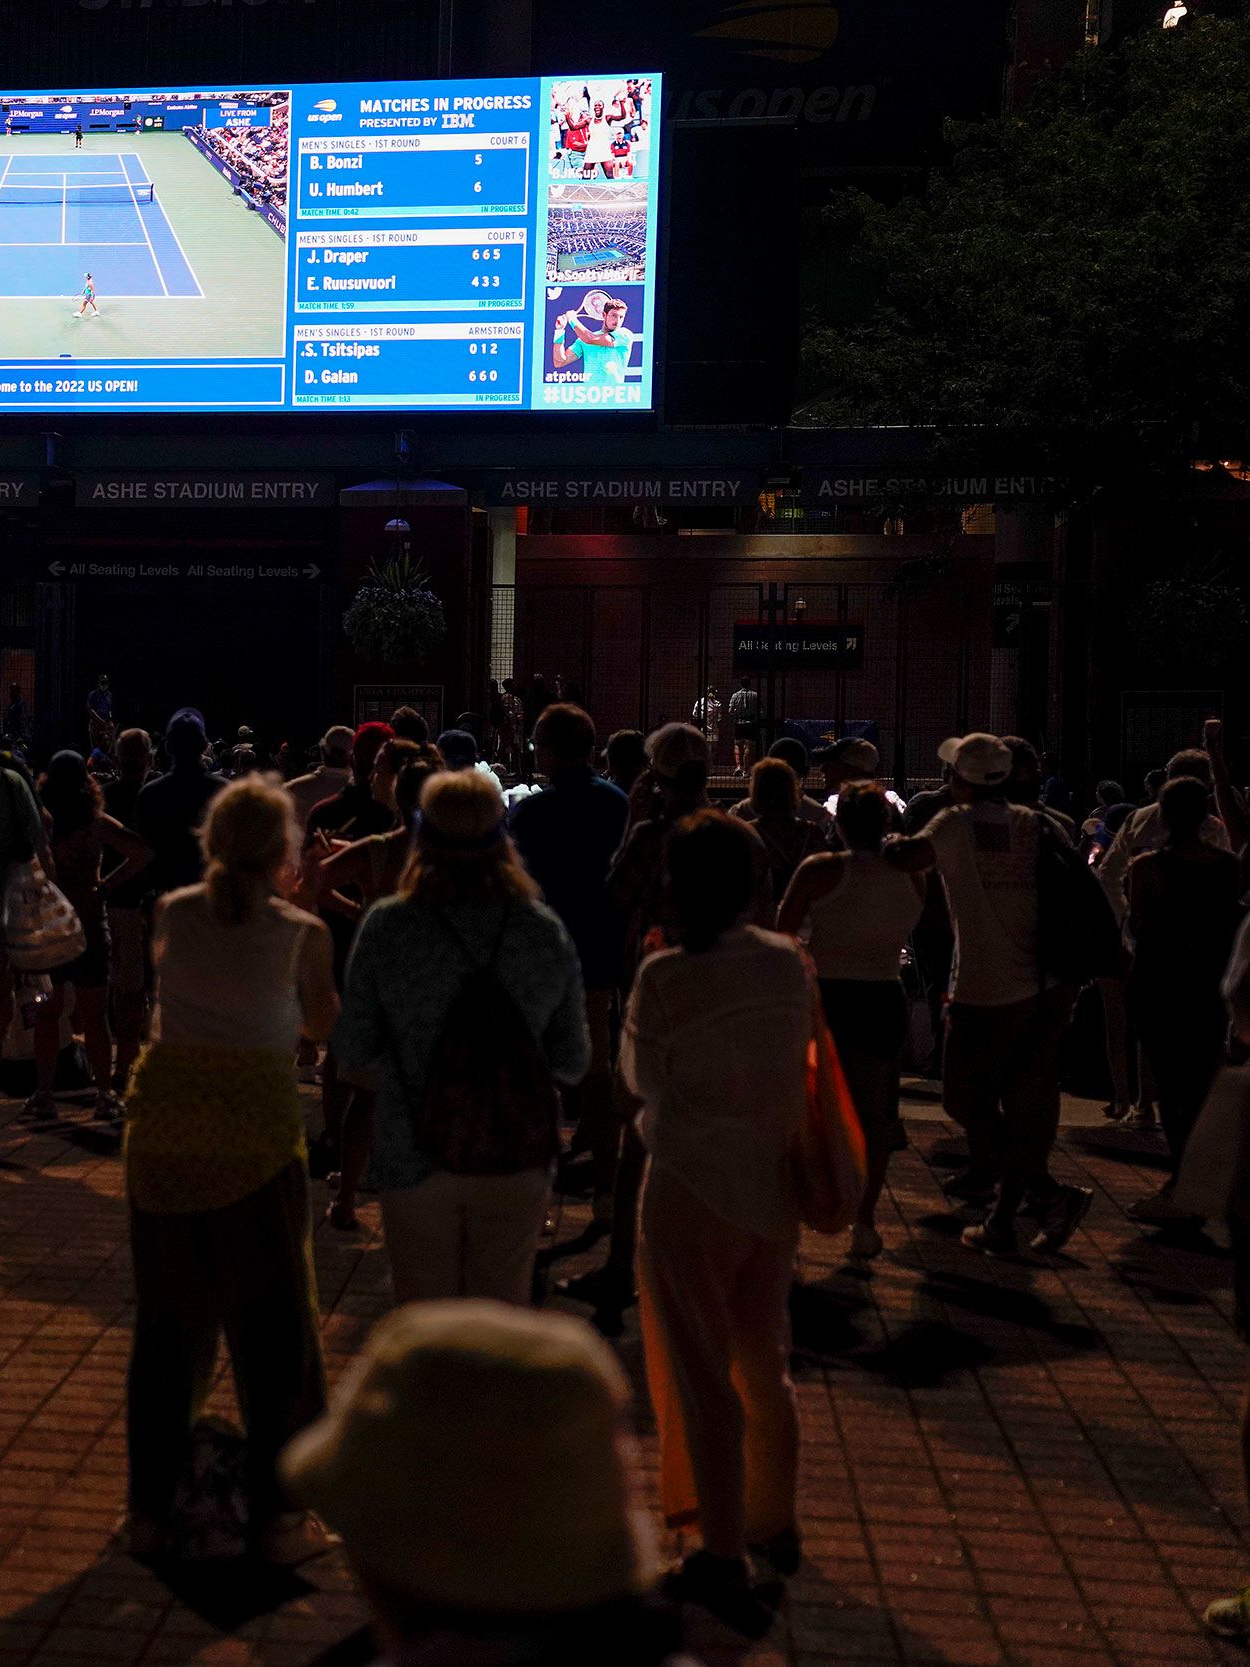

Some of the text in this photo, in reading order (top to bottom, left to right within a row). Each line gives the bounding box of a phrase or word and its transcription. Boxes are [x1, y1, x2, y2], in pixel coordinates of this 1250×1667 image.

[360, 95, 531, 113] MATCHES IN PROGRESS
[226, 118, 252, 126] ASHE
[360, 114, 475, 128] PRESENTED BY IBM
[302, 139, 420, 149] MEN'S SINGLES 1ST ROUND
[490, 136, 527, 145] COURT 6
[310, 155, 362, 169] B. Bonzi
[475, 154, 482, 165] 5
[310, 181, 383, 197] U. Humbert
[474, 182, 482, 192] 6
[300, 234, 417, 244] MEN'S SINGLES 1ST ROUND
[488, 232, 524, 240] COURT 9
[307, 250, 368, 265] J. Draper
[307, 275, 396, 291] E. Ruusuvuori
[297, 328, 415, 337] MEN'S SINGLES 1ST ROUND
[468, 327, 521, 335] ARMSTRONG
[321, 342, 380, 359] Tsitsipas
[305, 370, 358, 384] D. Galan
[20, 381, 31, 392] to
[34, 380, 53, 392] the
[55, 380, 85, 392] 2022
[88, 380, 102, 392] US
[105, 380, 138, 392] OPEN!
[543, 385, 640, 403] #USOPEN
[91, 482, 319, 500] ASHE STADIUM ENTRY
[500, 480, 741, 498] ASHE STADIUM ENTRY
[818, 479, 879, 497] ASHE
[70, 564, 179, 579] All Seating Levels
[187, 565, 299, 580] All Seating Levels
[738, 640, 753, 650] All
[802, 640, 837, 650] Levels
